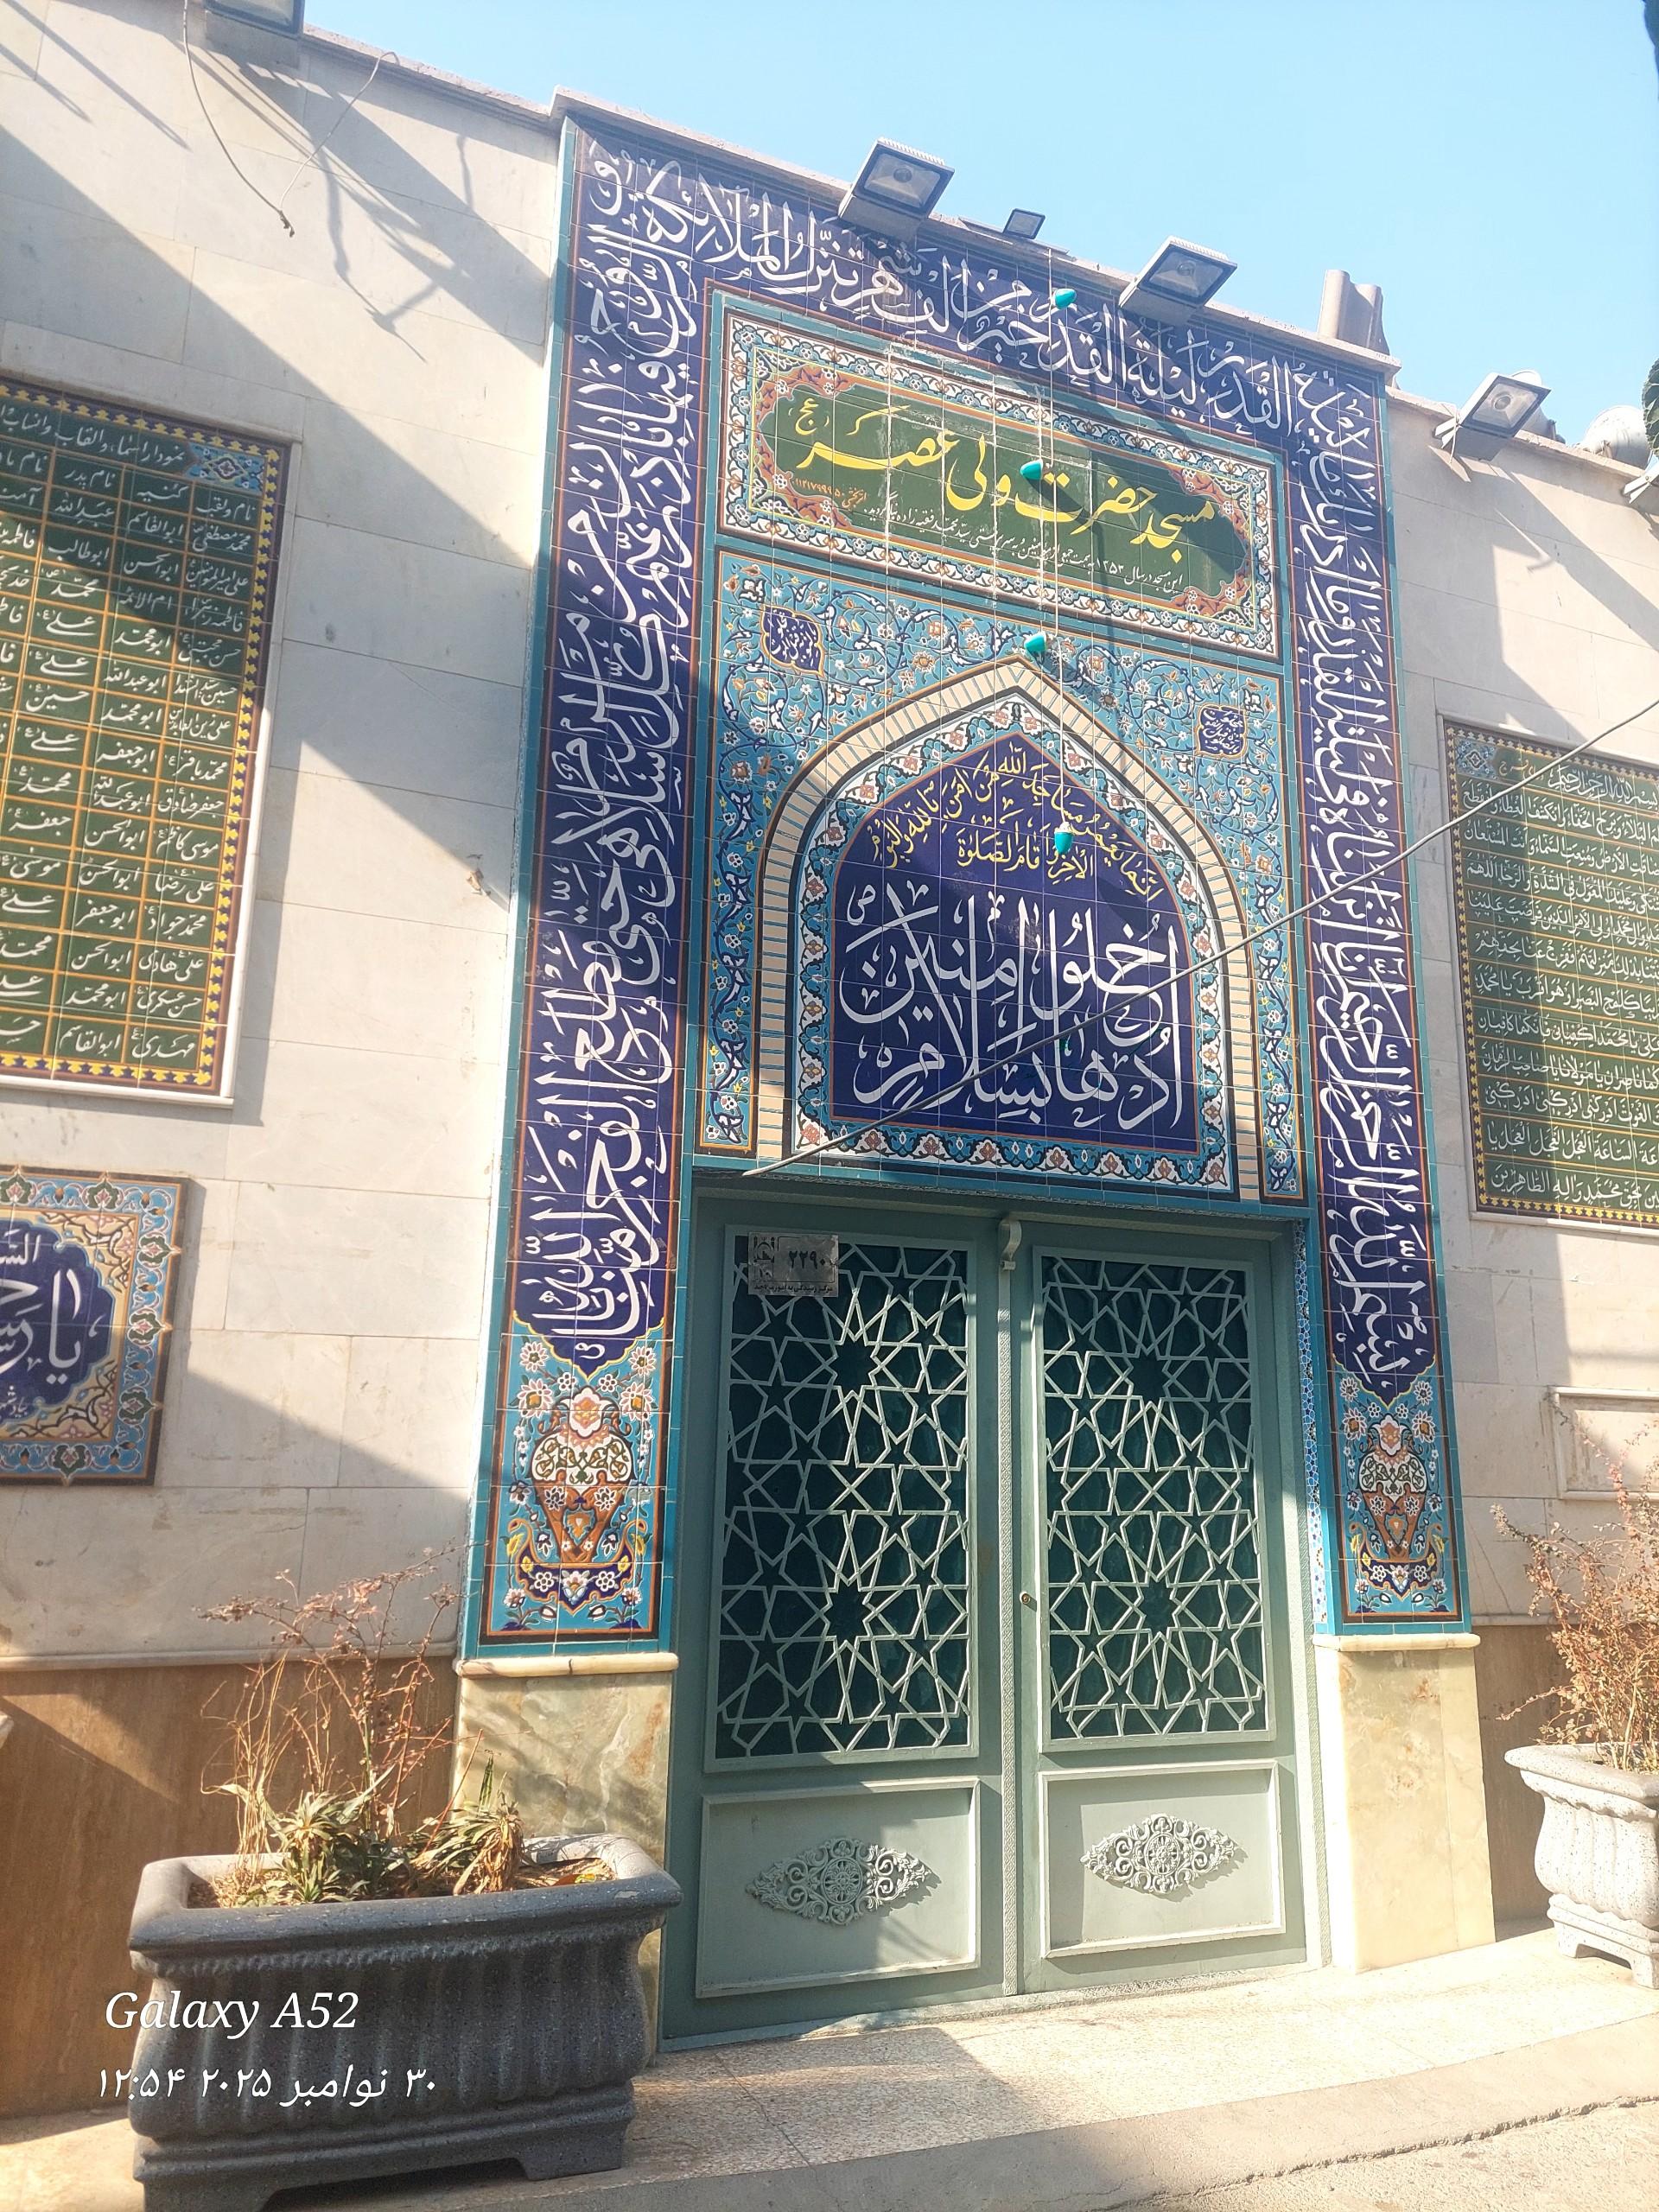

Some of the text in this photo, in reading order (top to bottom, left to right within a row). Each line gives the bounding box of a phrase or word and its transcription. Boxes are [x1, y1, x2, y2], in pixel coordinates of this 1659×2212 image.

[795, 430, 960, 470] عصر
[19, 450, 48, 474] نام
[945, 433, 1013, 512] ولی
[64, 469, 116, 490] نام پدر
[234, 502, 256, 520] نام
[1014, 474, 1157, 536] حضرت
[915, 509, 935, 533] فقیه
[931, 517, 959, 531] محمد
[1131, 501, 1215, 562] مسجد
[226, 533, 251, 552] محمد
[954, 523, 971, 543] سید
[224, 570, 249, 596] علی
[1124, 566, 1145, 586] سال
[1153, 570, 1172, 590] مسجد
[1163, 574, 1184, 593] این
[46, 611, 97, 636] علی
[40, 654, 90, 677] علی
[208, 647, 242, 668] حسن
[25, 690, 90, 712] حسین
[30, 730, 80, 752] علی
[199, 760, 228, 780] محمد
[185, 880, 214, 904] علی
[178, 914, 207, 937] محمد
[174, 956, 204, 982] علی
[167, 995, 202, 1019] حسن
